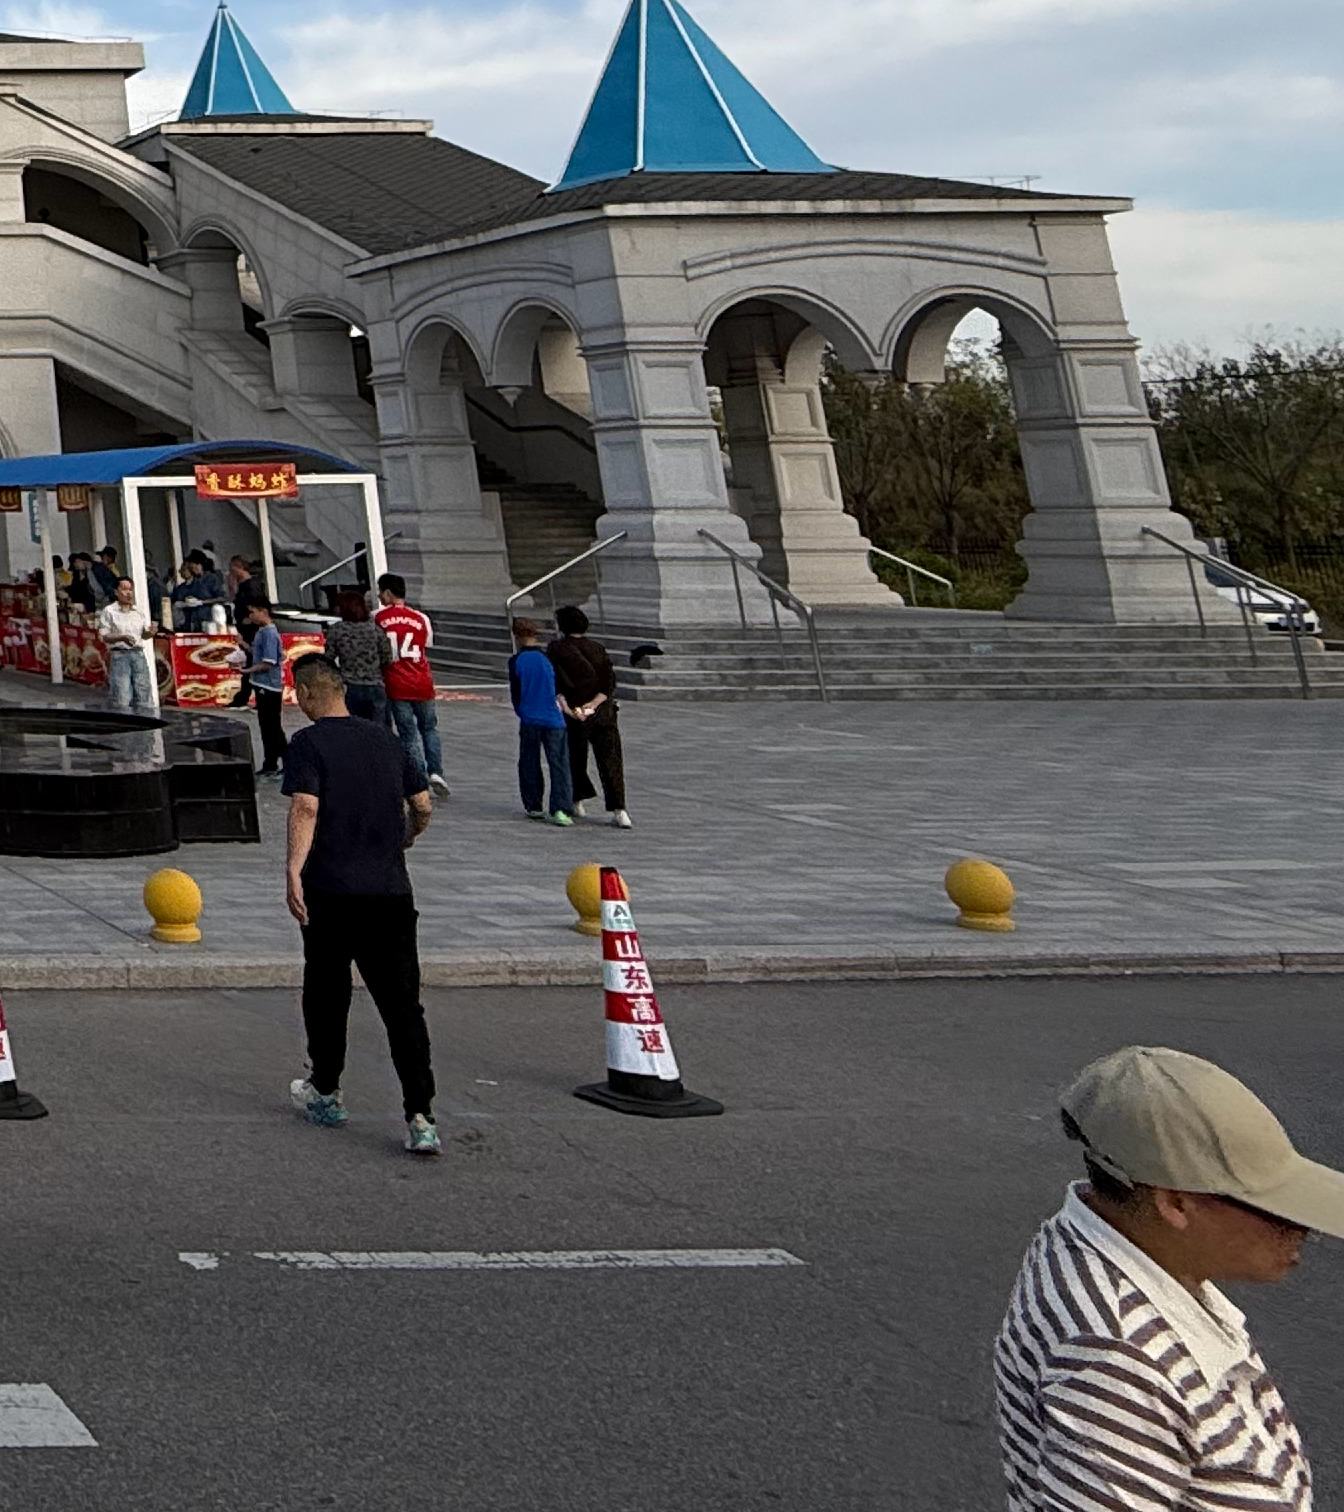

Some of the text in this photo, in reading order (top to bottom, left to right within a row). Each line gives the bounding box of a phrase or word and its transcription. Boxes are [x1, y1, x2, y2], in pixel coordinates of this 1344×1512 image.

[386, 631, 422, 663] 14
[615, 935, 666, 1053] 山东高速
